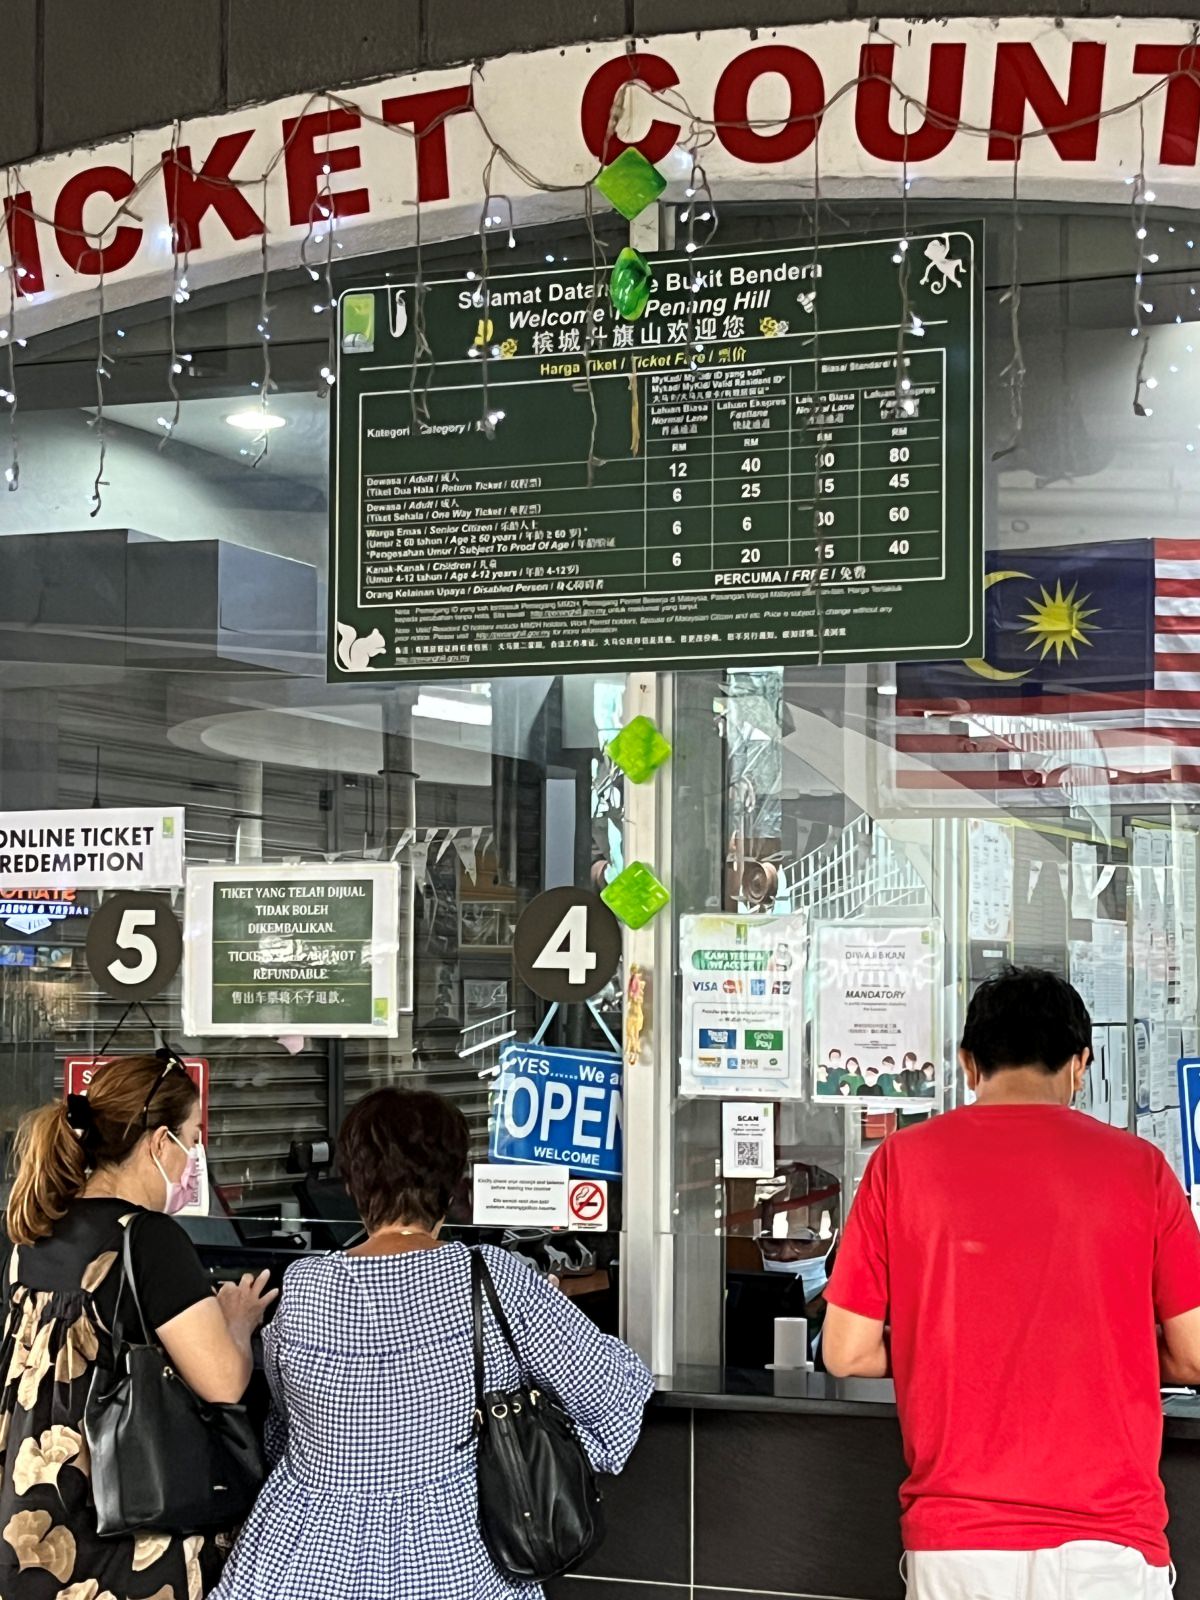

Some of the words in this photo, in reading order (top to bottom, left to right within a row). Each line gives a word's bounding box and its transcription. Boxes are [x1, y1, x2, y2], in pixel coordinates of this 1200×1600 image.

[458, 286, 542, 310] Selamat
[666, 270, 723, 292] Bukit
[730, 262, 822, 286] Bendera
[509, 306, 604, 330] Welcome
[644, 298, 727, 318] Penang
[734, 289, 771, 311] Hill
[541, 362, 580, 376] Harga
[588, 359, 617, 371] Tiket
[633, 354, 671, 369] Ticket
[651, 415, 684, 425] Normal
[367, 426, 410, 439] Kategori
[671, 442, 687, 452] RM
[743, 438, 759, 447] RM
[889, 447, 910, 463] 80
[669, 462, 687, 477] 12
[740, 457, 761, 472] 40
[366, 477, 402, 487] Dewasa
[408, 474, 434, 484] Adult
[393, 486, 412, 495] Dua
[413, 485, 434, 494] Hala
[441, 483, 473, 493] Return
[475, 481, 503, 490] Ticket
[888, 473, 910, 488] 45
[672, 487, 682, 502] 6
[741, 483, 761, 498] 25
[366, 503, 402, 512] Dewasa
[408, 501, 434, 510] Adult
[393, 512, 424, 521] Sehala
[431, 510, 450, 519] One
[452, 509, 472, 519] Way
[475, 507, 502, 517] Ticket
[889, 506, 910, 522] 60
[365, 529, 395, 538] Warga
[396, 527, 422, 536] Emas
[429, 525, 459, 535] Senior
[461, 523, 493, 533] Citizen
[672, 520, 682, 535] 6
[742, 516, 752, 531] 6
[403, 538, 415, 546] 60
[416, 537, 443, 546] tahun
[450, 535, 469, 546] Age
[478, 534, 491, 542] 60
[492, 532, 517, 543] years
[554, 529, 567, 538] 60
[427, 547, 452, 556] Umur
[459, 545, 494, 555] Subject
[497, 543, 508, 552] To
[510, 542, 536, 552] Proof
[538, 541, 549, 551] Of
[550, 541, 570, 551] Age
[814, 544, 835, 559] 15
[888, 540, 910, 555] 40
[672, 552, 682, 567] 6
[741, 548, 761, 563] 20
[366, 564, 425, 574] Kanak-Kanak
[432, 561, 472, 571] Children
[395, 573, 415, 583] 4-12
[416, 572, 443, 582] tahun
[450, 571, 469, 581] Age
[471, 569, 491, 579] 4-12
[492, 569, 518, 580] years
[714, 572, 782, 585] PERCUMA
[365, 590, 394, 600] Orang
[395, 588, 434, 598] Kelainan
[436, 587, 466, 597] Upaya
[473, 583, 514, 595] Disabled
[515, 582, 549, 593] Person
[81, 827, 154, 847] TICKET
[0, 852, 144, 873] REDEMPTION
[220, 888, 254, 899] TIKET
[256, 887, 286, 898] YANG
[288, 886, 325, 898] TELAH
[327, 886, 366, 899] DIJUAL
[255, 905, 290, 916] TIDAK
[292, 904, 328, 915] BOLEH
[107, 909, 158, 985] 5
[531, 905, 597, 984] 4
[332, 950, 356, 961] NOT
[693, 981, 718, 991] VISA
[845, 990, 906, 999] MANDATORY
[753, 1031, 774, 1040] Grab
[755, 1039, 772, 1050] Pay
[533, 1145, 601, 1166] WELCOME
